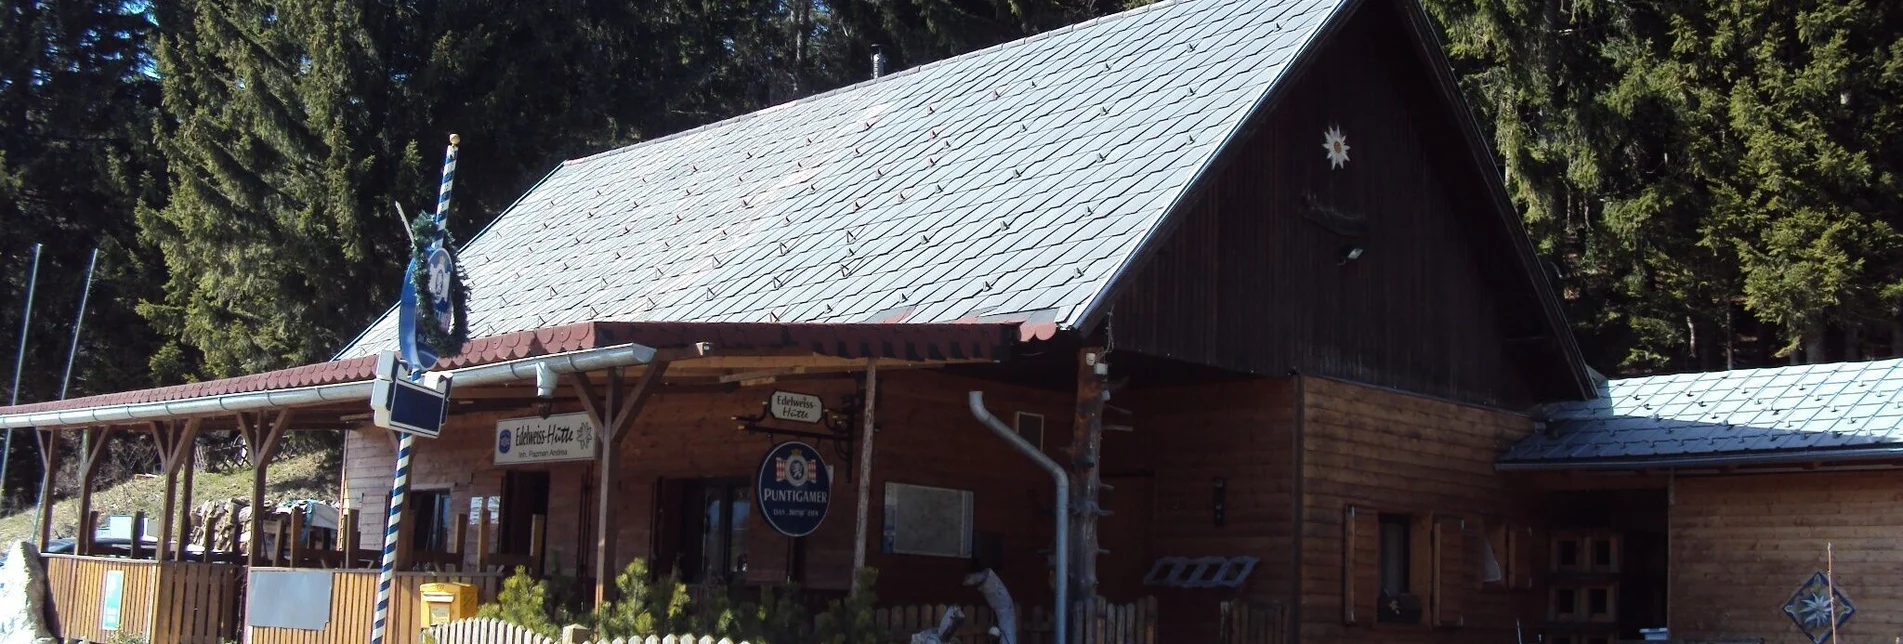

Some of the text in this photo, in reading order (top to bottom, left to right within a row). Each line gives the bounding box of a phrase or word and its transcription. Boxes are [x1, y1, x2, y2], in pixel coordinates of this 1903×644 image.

[777, 396, 817, 409] Edelweiss-
[783, 407, 809, 419] Hütte
[515, 424, 574, 447] Edelweiss-Hütte
[549, 448, 568, 457] Andrea
[764, 487, 828, 503] PUNTIGAMER
